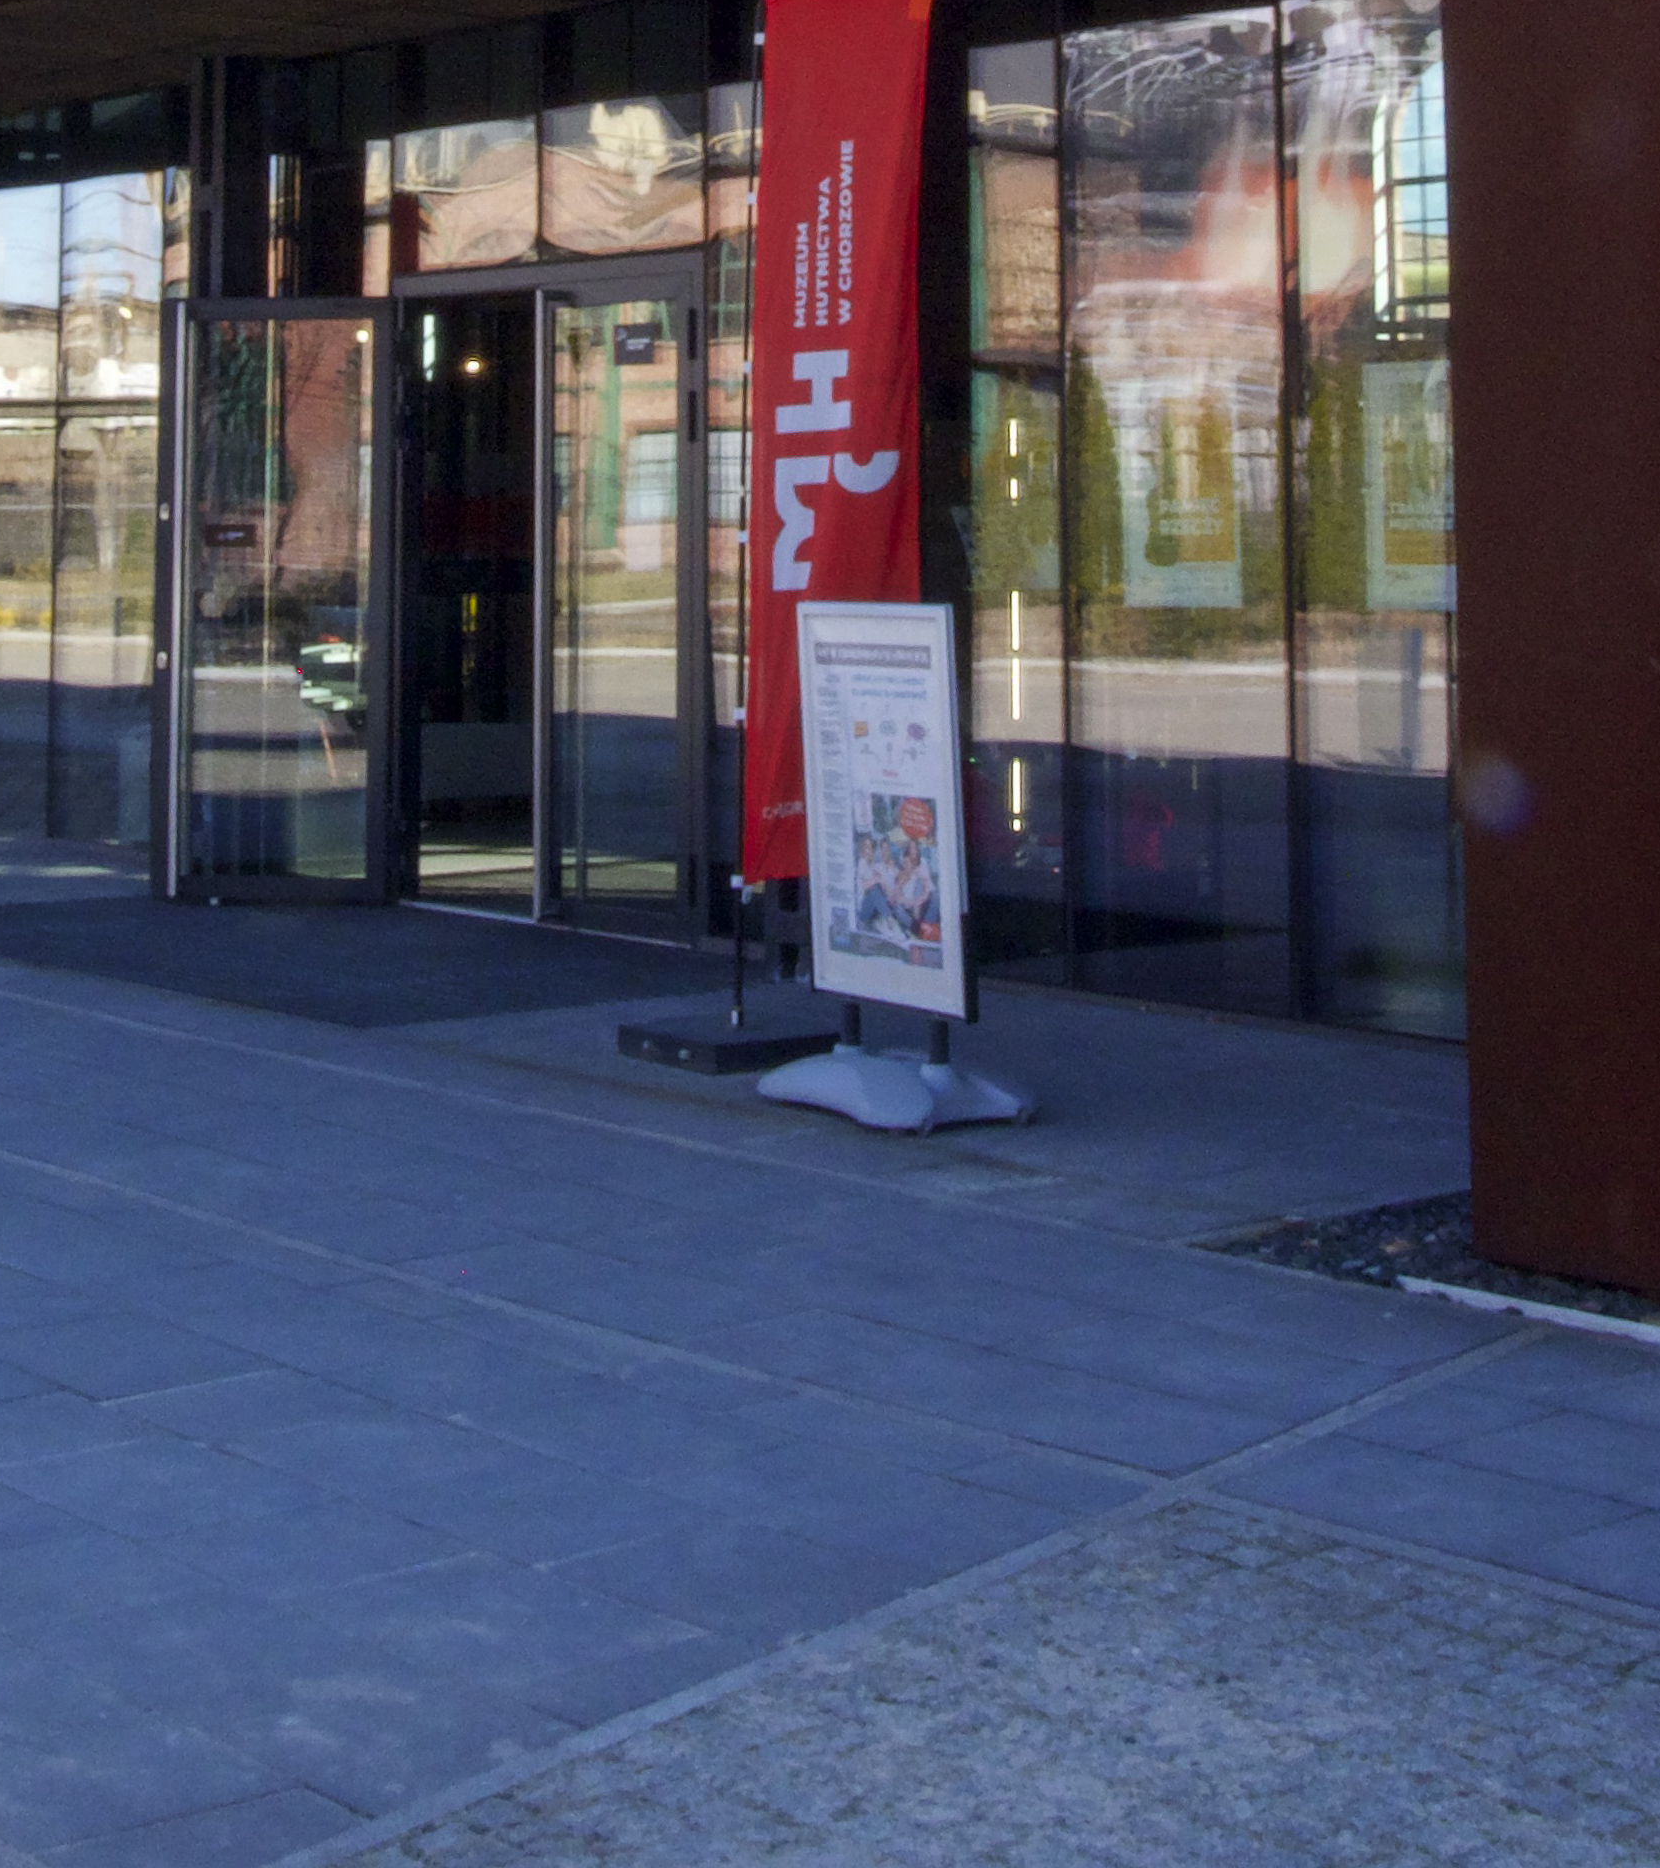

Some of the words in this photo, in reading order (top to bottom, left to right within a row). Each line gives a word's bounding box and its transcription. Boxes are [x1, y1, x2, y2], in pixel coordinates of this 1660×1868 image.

[794, 222, 809, 328] MUZEUM
[815, 176, 832, 327] HUTNICTWA
[838, 139, 854, 292] CHORZOWIE
[838, 299, 852, 325] W
